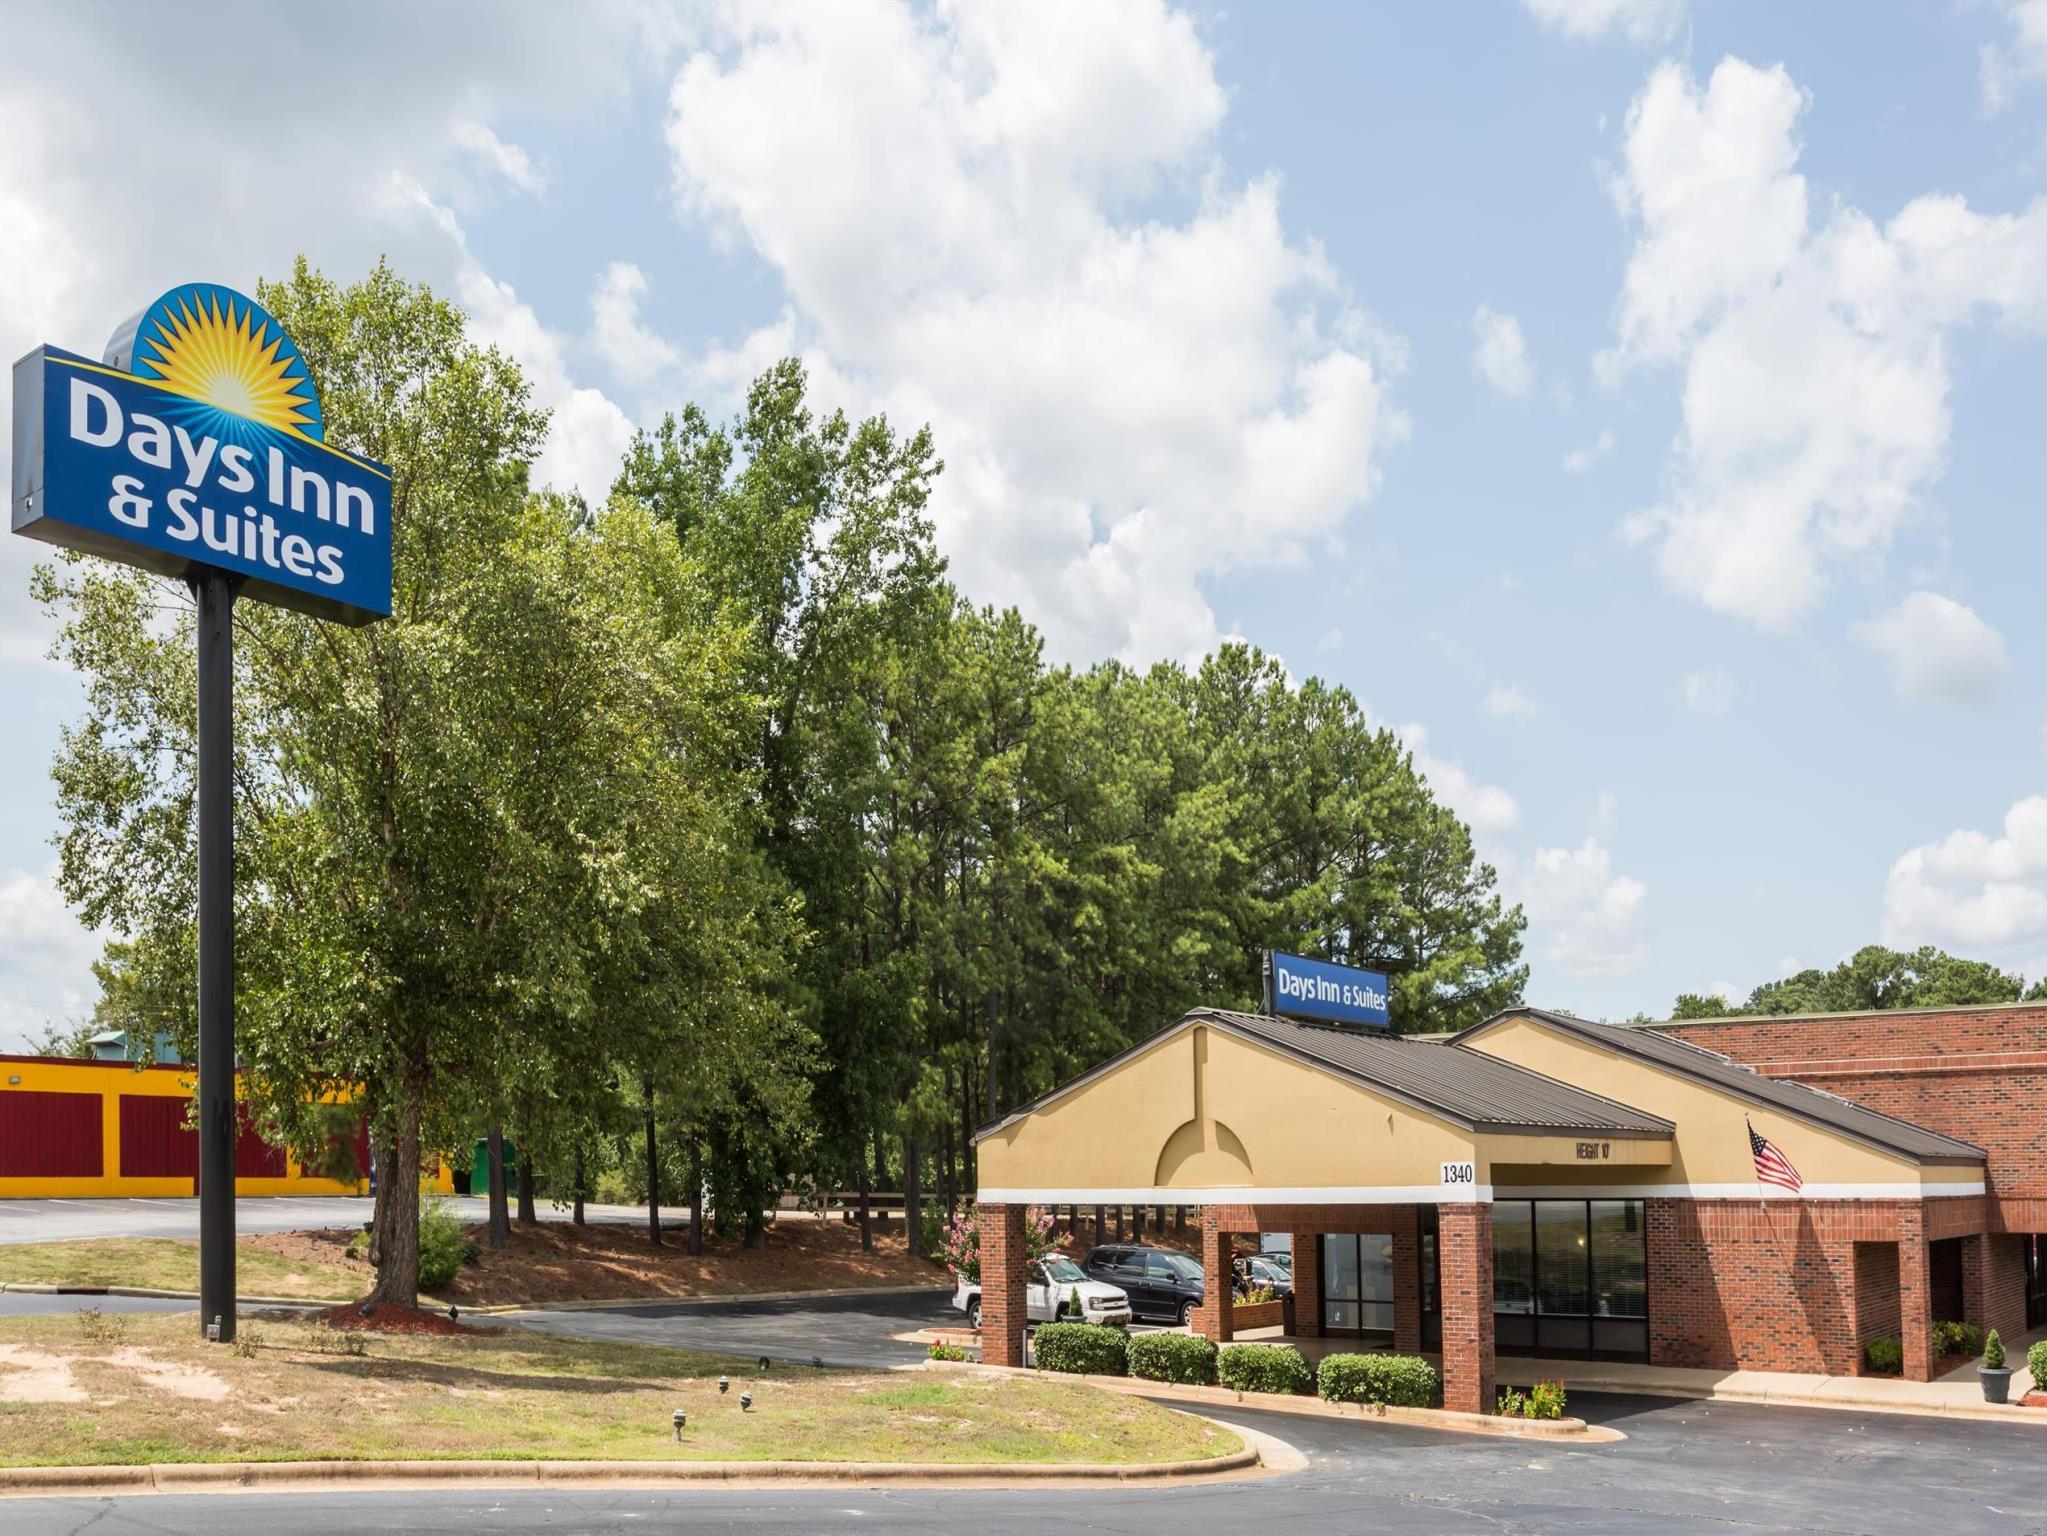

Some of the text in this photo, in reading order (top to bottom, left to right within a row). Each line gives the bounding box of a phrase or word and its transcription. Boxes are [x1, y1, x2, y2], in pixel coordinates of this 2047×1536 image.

[70, 377, 375, 536] Days Inn
[107, 474, 345, 585] & Suites
[1278, 968, 1386, 1011] Days Inn & Suites
[1576, 1142, 1600, 1159] HEIGHT
[1443, 1164, 1473, 1183] 1340
